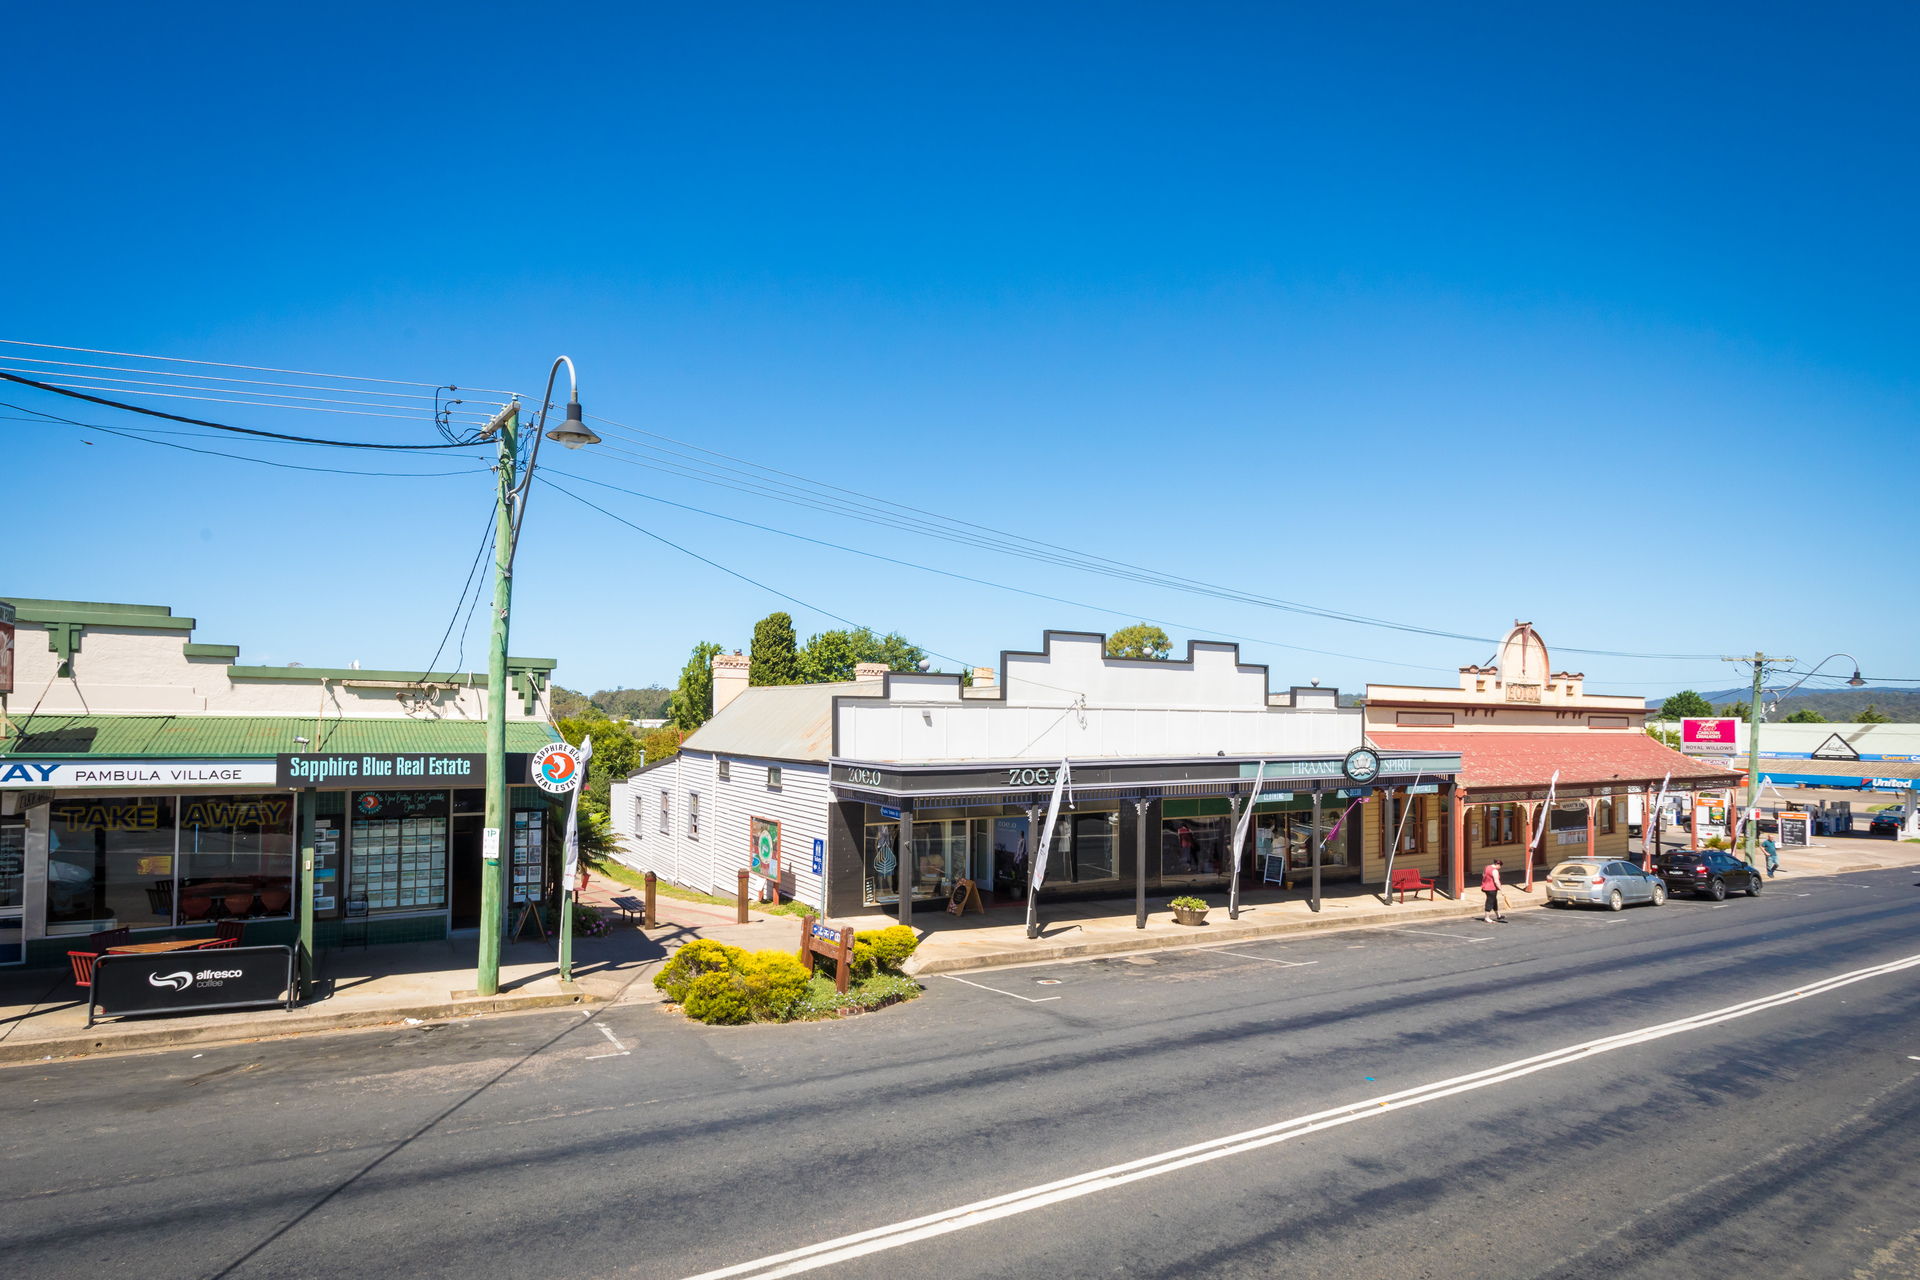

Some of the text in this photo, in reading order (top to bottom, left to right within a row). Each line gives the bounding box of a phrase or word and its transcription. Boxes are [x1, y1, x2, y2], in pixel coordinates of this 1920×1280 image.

[1508, 685, 1540, 701] HOTEL
[534, 744, 568, 765] SAPPHIRE
[290, 757, 471, 782] Sapphire Blue Real Estate
[1292, 761, 1335, 775] HRAANI
[1384, 759, 1413, 771] SPIRIT
[0, 765, 242, 782] AY PAMBULA VILLAGE
[535, 773, 551, 790] REAL
[849, 767, 881, 785] zoe.o
[1872, 778, 1912, 788] United
[60, 802, 287, 832] TAKE AWAY
[196, 969, 243, 980] alfresco
[197, 979, 223, 988] coffee
